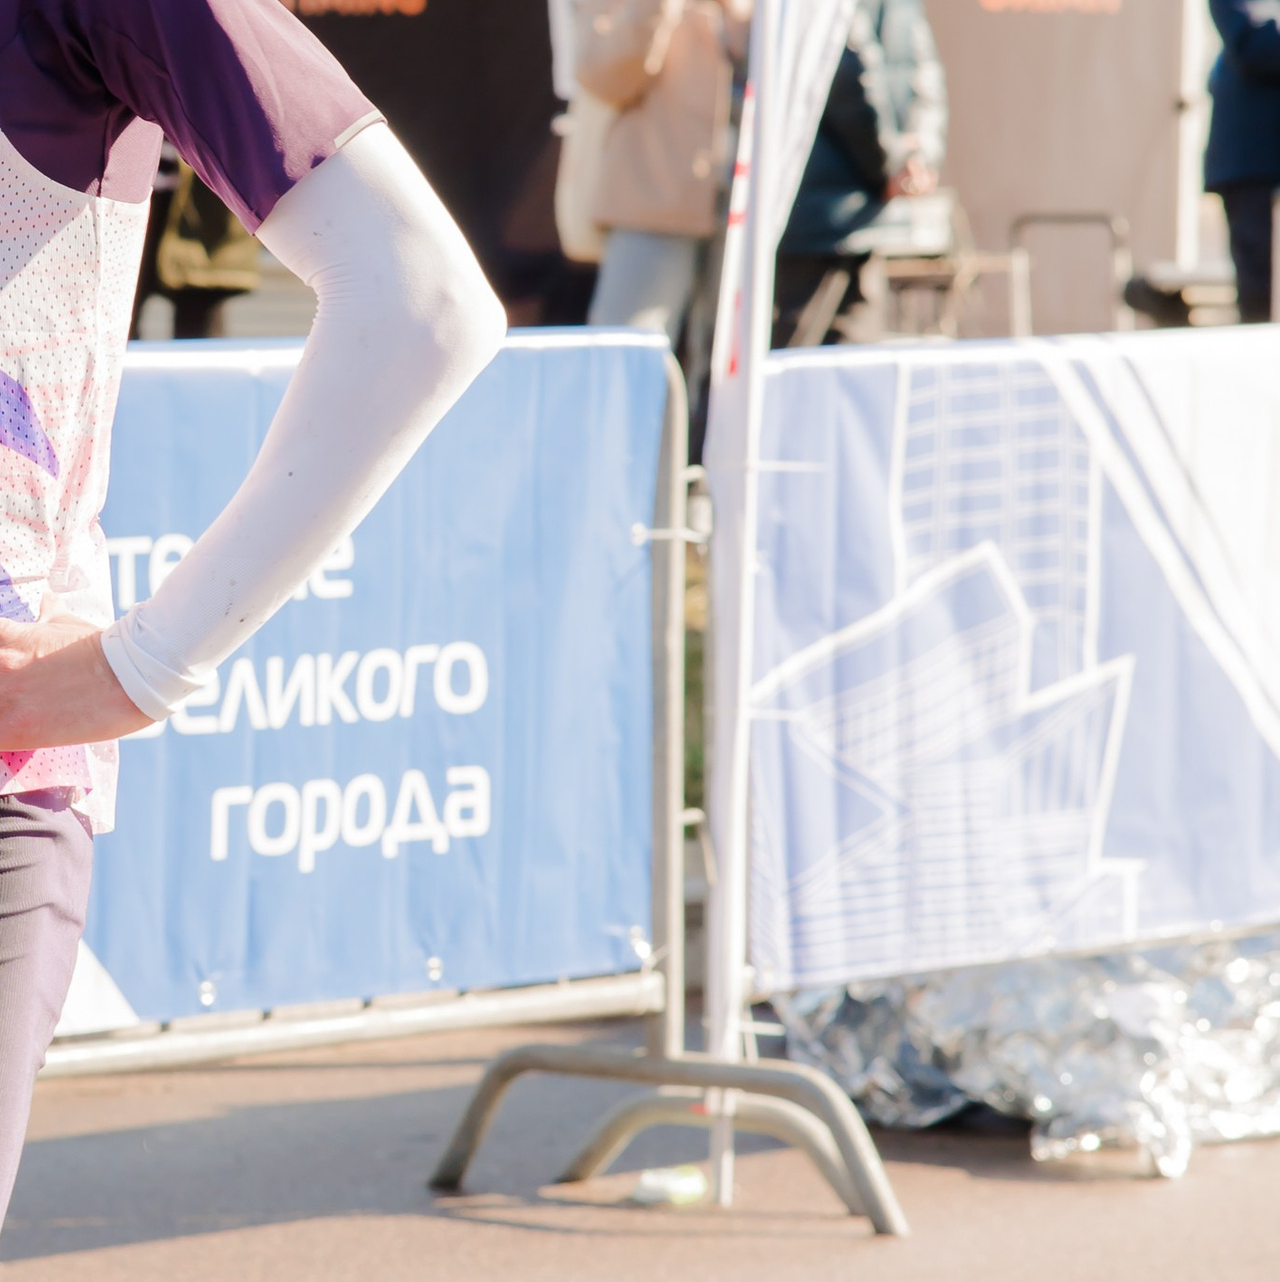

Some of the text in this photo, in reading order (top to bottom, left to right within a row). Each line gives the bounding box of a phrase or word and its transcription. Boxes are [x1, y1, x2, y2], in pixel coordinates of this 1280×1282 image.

[107, 531, 355, 611] тее
[122, 640, 489, 741] еликого
[209, 764, 491, 874] города
